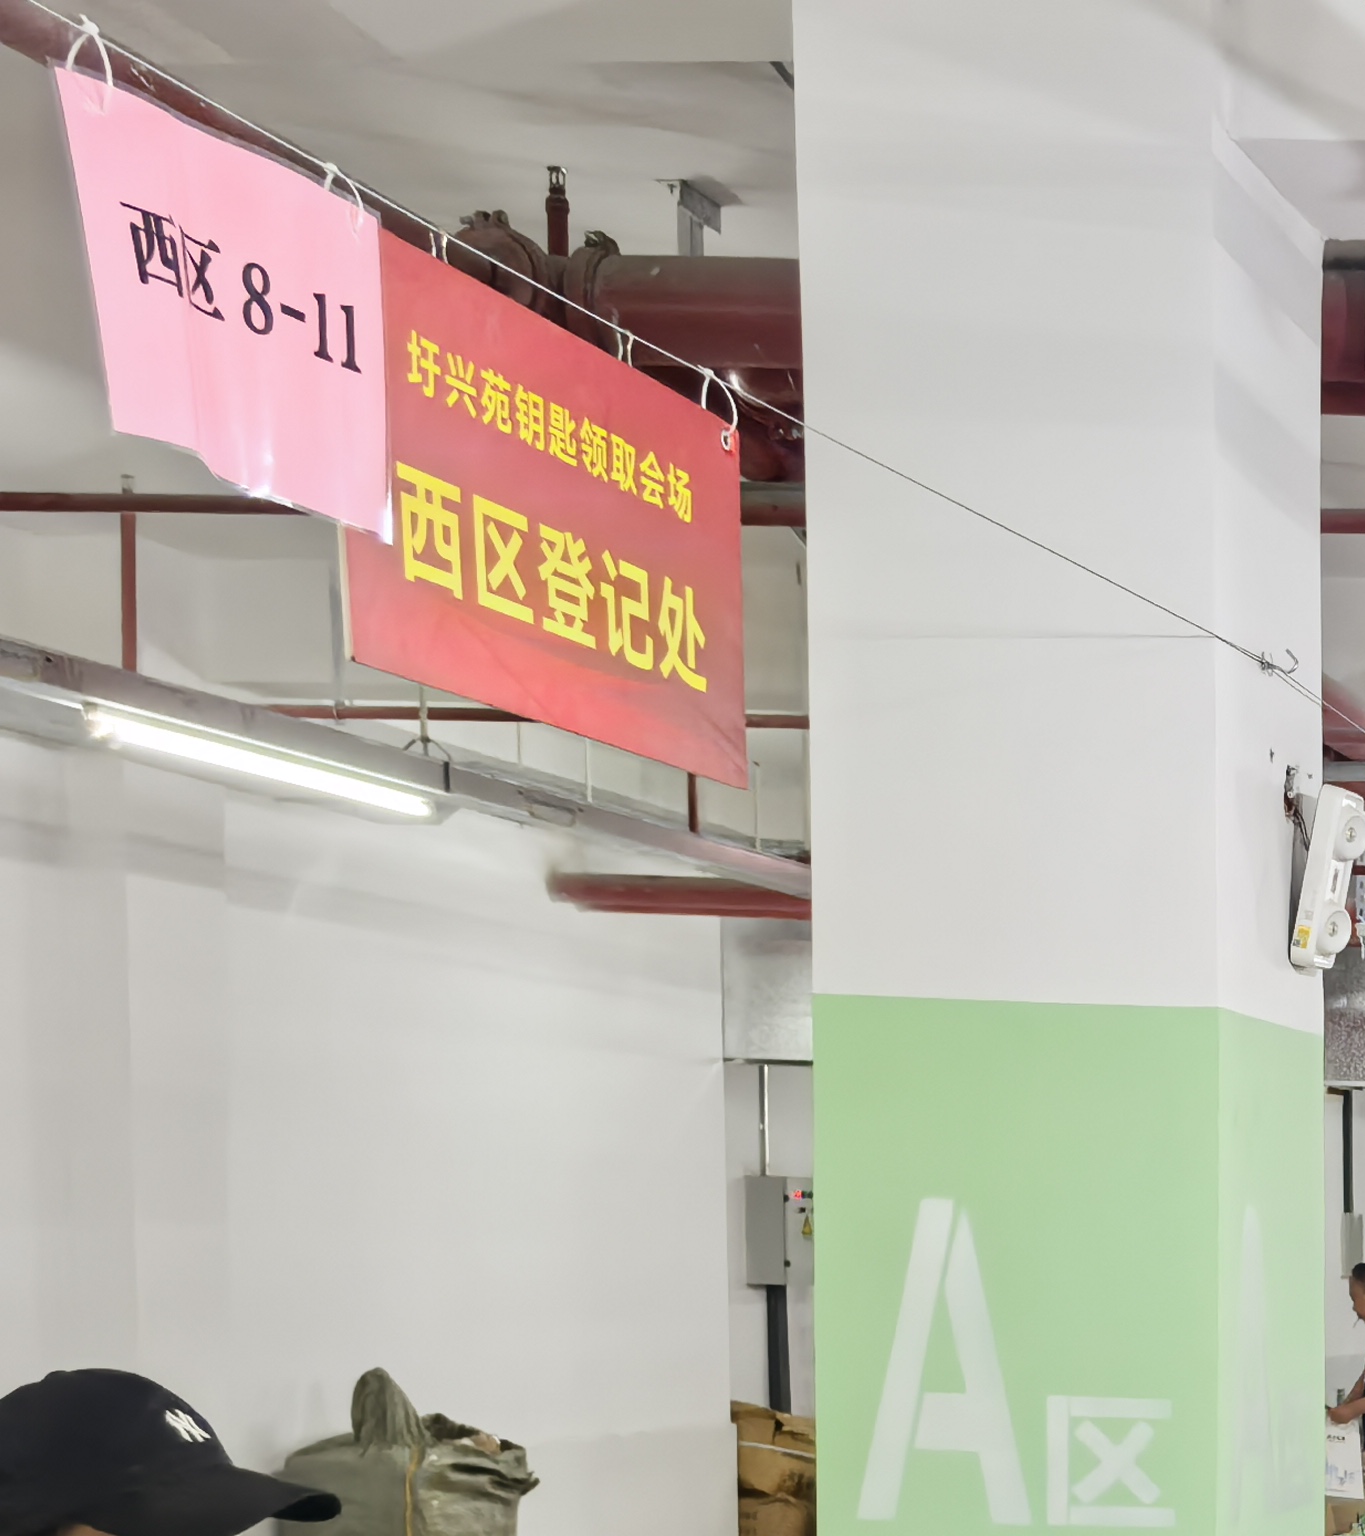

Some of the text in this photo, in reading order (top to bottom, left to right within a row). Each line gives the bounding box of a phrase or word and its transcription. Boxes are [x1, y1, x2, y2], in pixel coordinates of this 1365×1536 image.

[120, 202, 362, 373] 西区 8-11
[407, 330, 694, 524] 圩兴苑钥匙领取会场
[395, 461, 709, 694] 西区登记处
[857, 1197, 1177, 1527] A区
